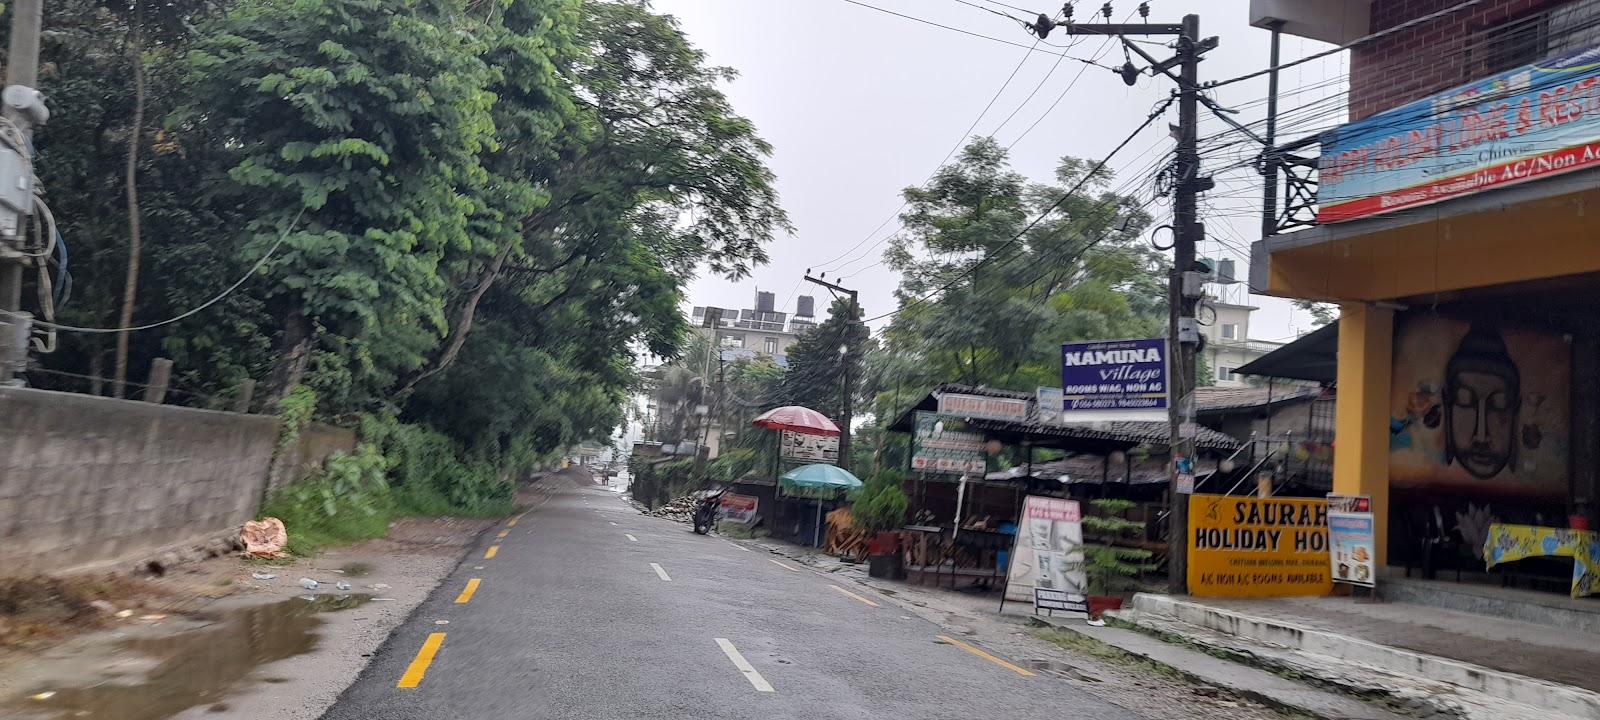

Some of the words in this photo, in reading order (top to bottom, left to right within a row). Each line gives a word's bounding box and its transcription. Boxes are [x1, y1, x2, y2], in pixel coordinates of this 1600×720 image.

[1319, 144, 1370, 188] HAPPY
[1373, 122, 1446, 172] HOLIDAY
[1449, 102, 1510, 152] LODGE
[1515, 97, 1532, 134] &
[1539, 75, 1600, 128] REST
[1380, 188, 1428, 208] Rooms
[1431, 170, 1497, 196] Available
[1501, 152, 1577, 180] AC/Non
[1065, 348, 1162, 366] NAMUNA
[1099, 365, 1161, 383] Village
[1066, 385, 1097, 394] ROOMS
[1126, 383, 1147, 392] NON
[1149, 382, 1162, 391] AC
[944, 397, 982, 410] GUEST
[986, 400, 1025, 413] HOUSE
[1196, 529, 1282, 551] HOLIDAY
[1253, 574, 1283, 584] ROOMS
[1287, 574, 1324, 584] AVAILABLE
